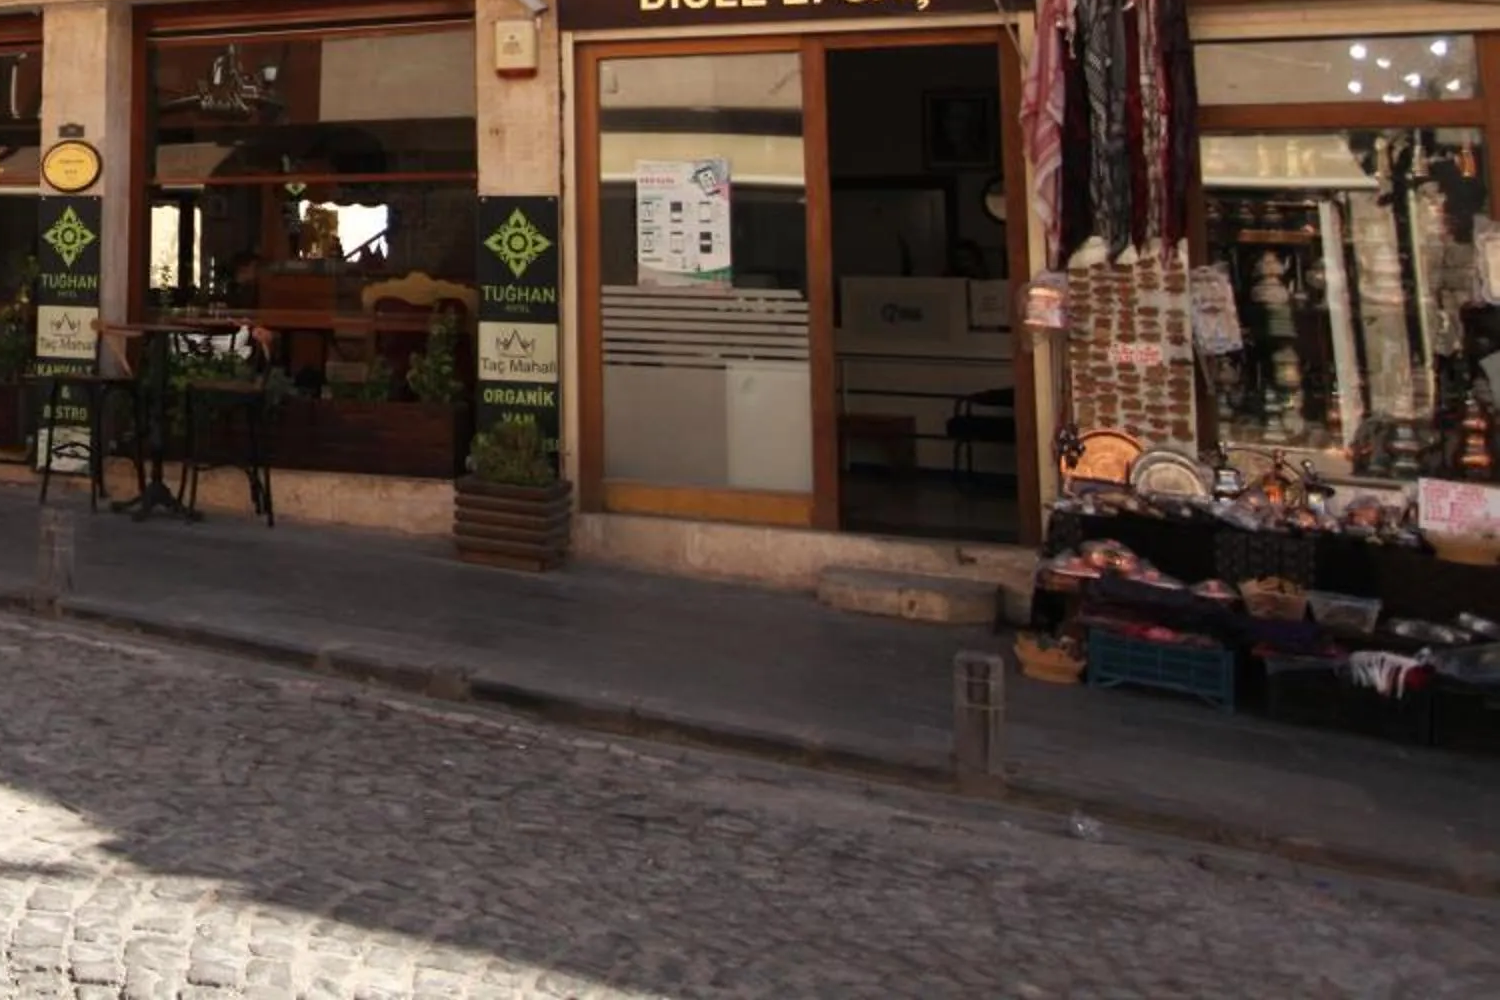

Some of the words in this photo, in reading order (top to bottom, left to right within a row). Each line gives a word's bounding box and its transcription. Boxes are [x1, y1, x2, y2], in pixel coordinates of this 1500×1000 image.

[482, 284, 556, 304] TUĞHAN
[480, 357, 506, 375] Taç
[483, 386, 556, 407] ORGANİK
[43, 404, 88, 421] BSTRO
